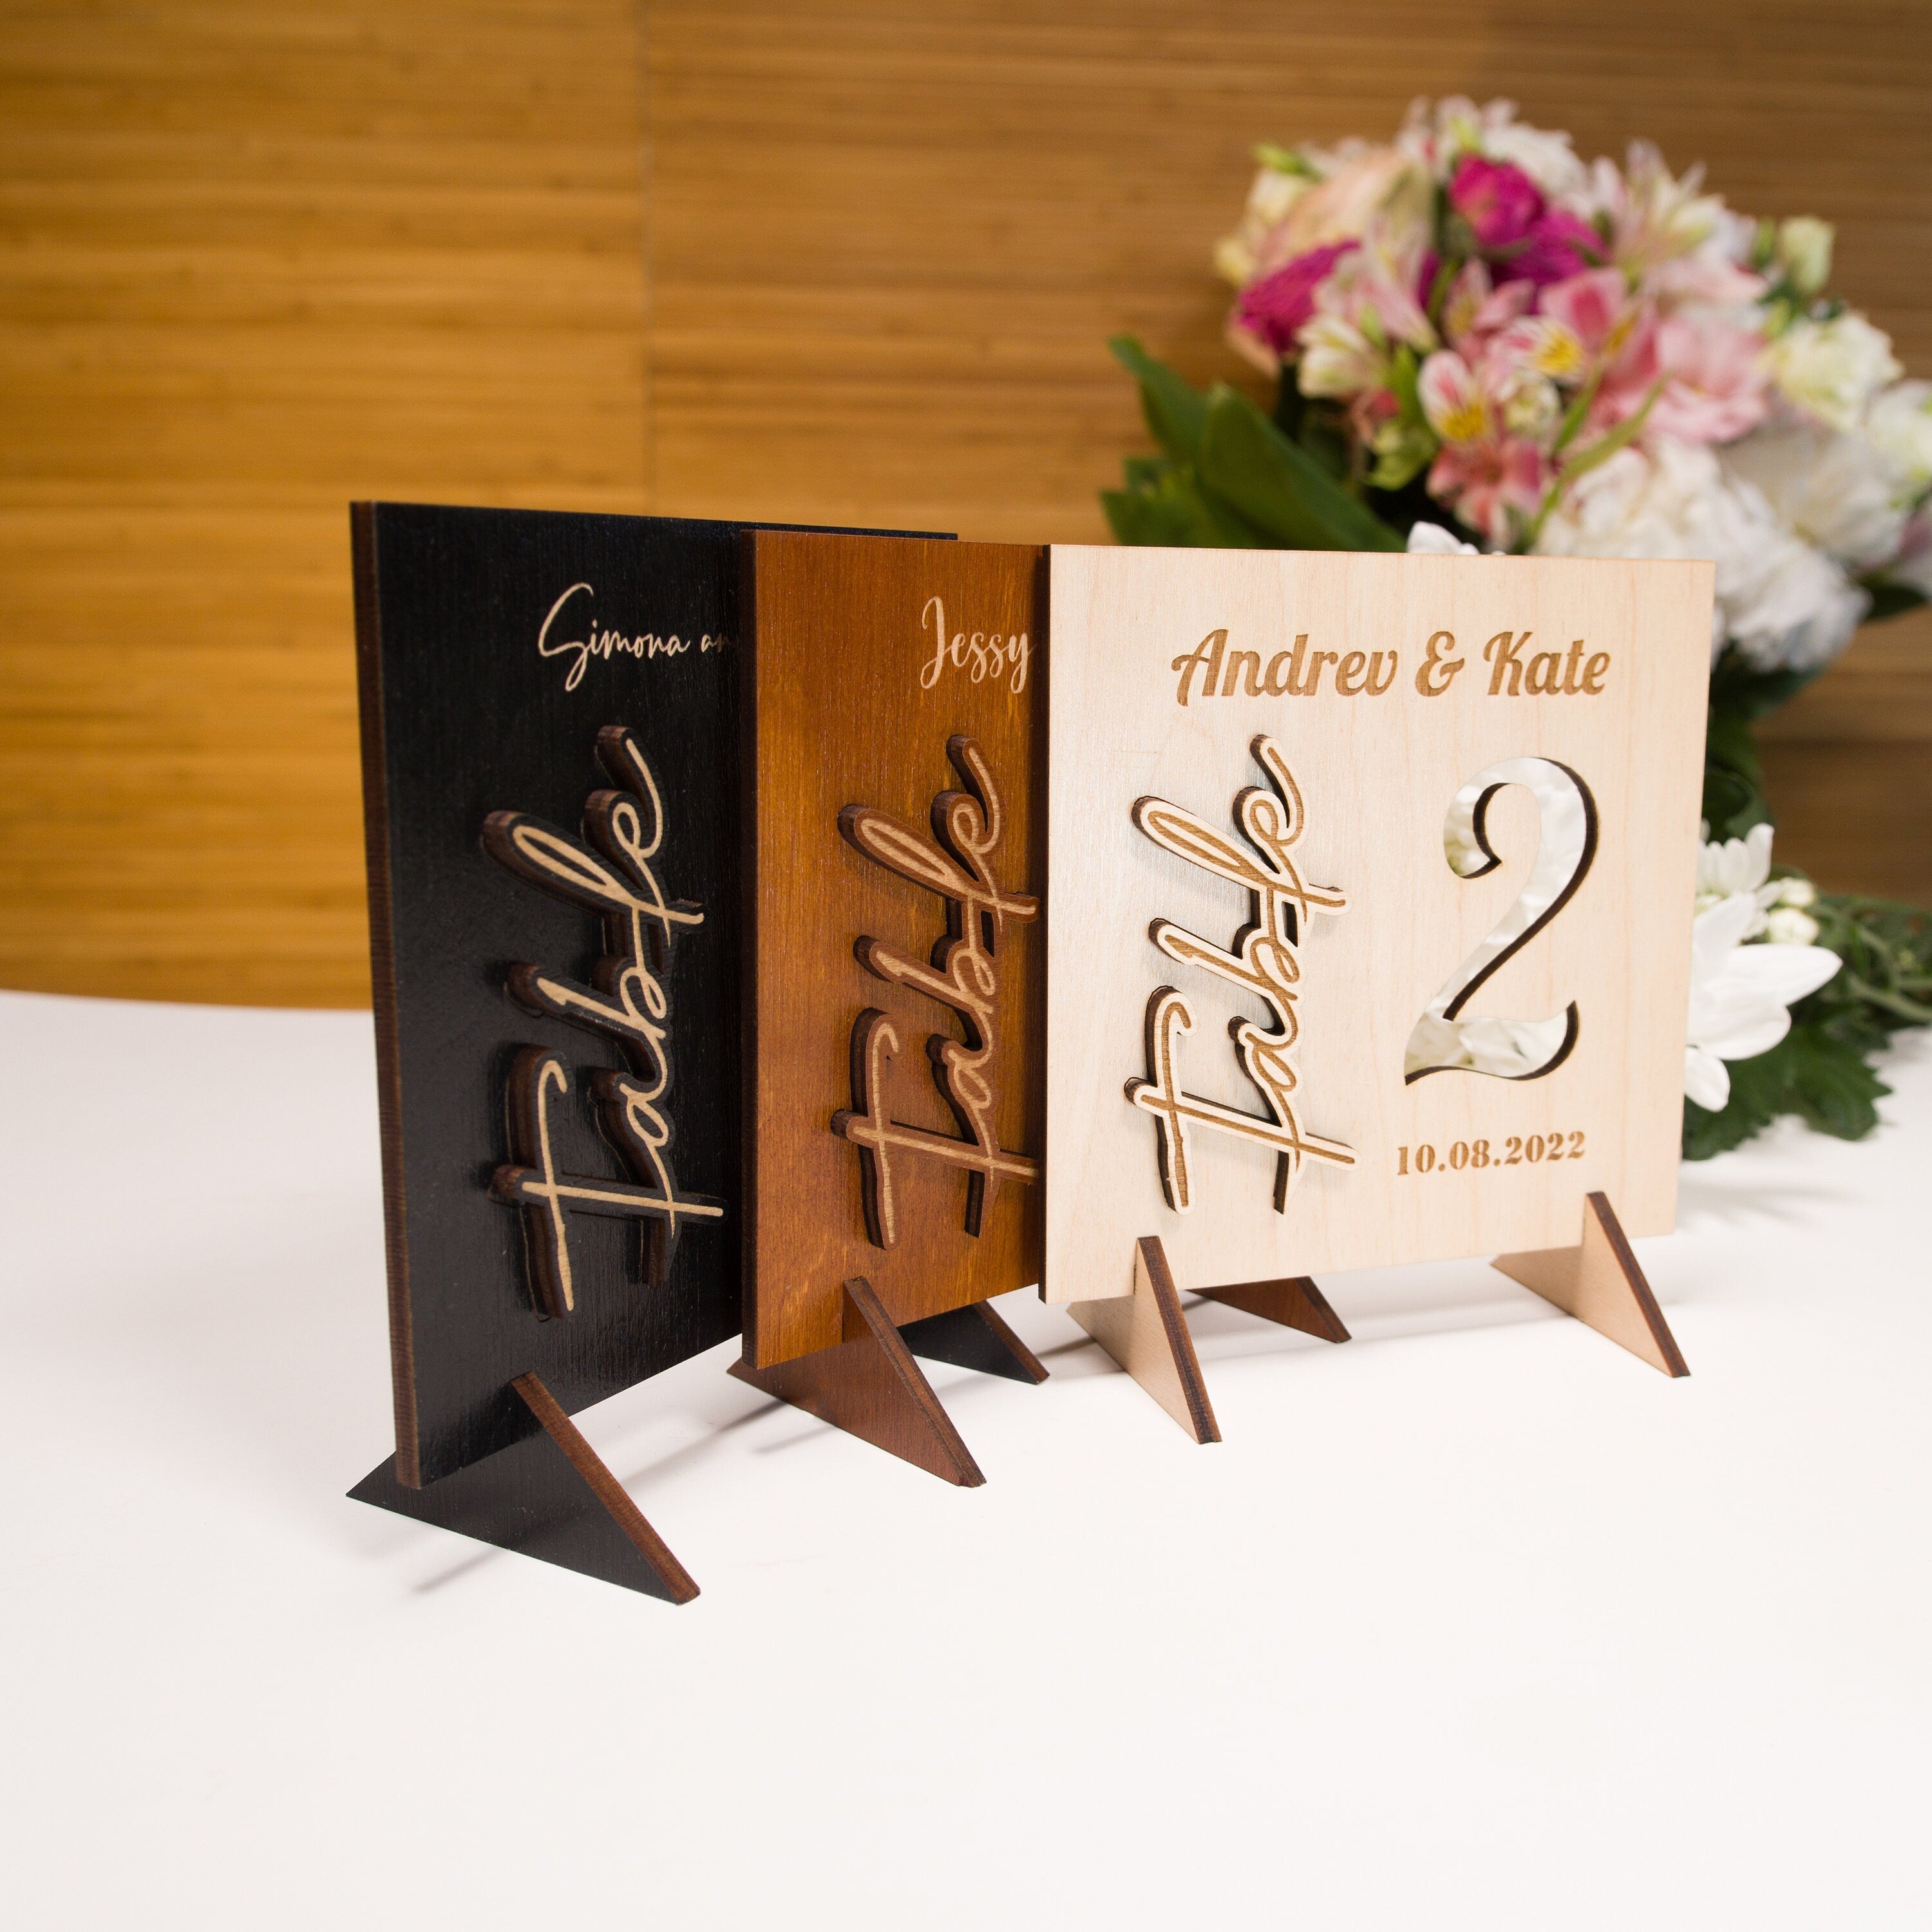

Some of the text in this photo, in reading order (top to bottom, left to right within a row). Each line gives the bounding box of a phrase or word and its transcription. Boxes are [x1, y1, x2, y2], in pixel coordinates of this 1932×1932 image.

[538, 582, 690, 692] Simona
[920, 595, 1032, 694] Jessy
[1171, 629, 1611, 707] Andrev & Kate
[1403, 756, 1600, 1086] 2
[1126, 735, 1358, 1216] Table
[1396, 1130, 1587, 1176] 10.08.2022
